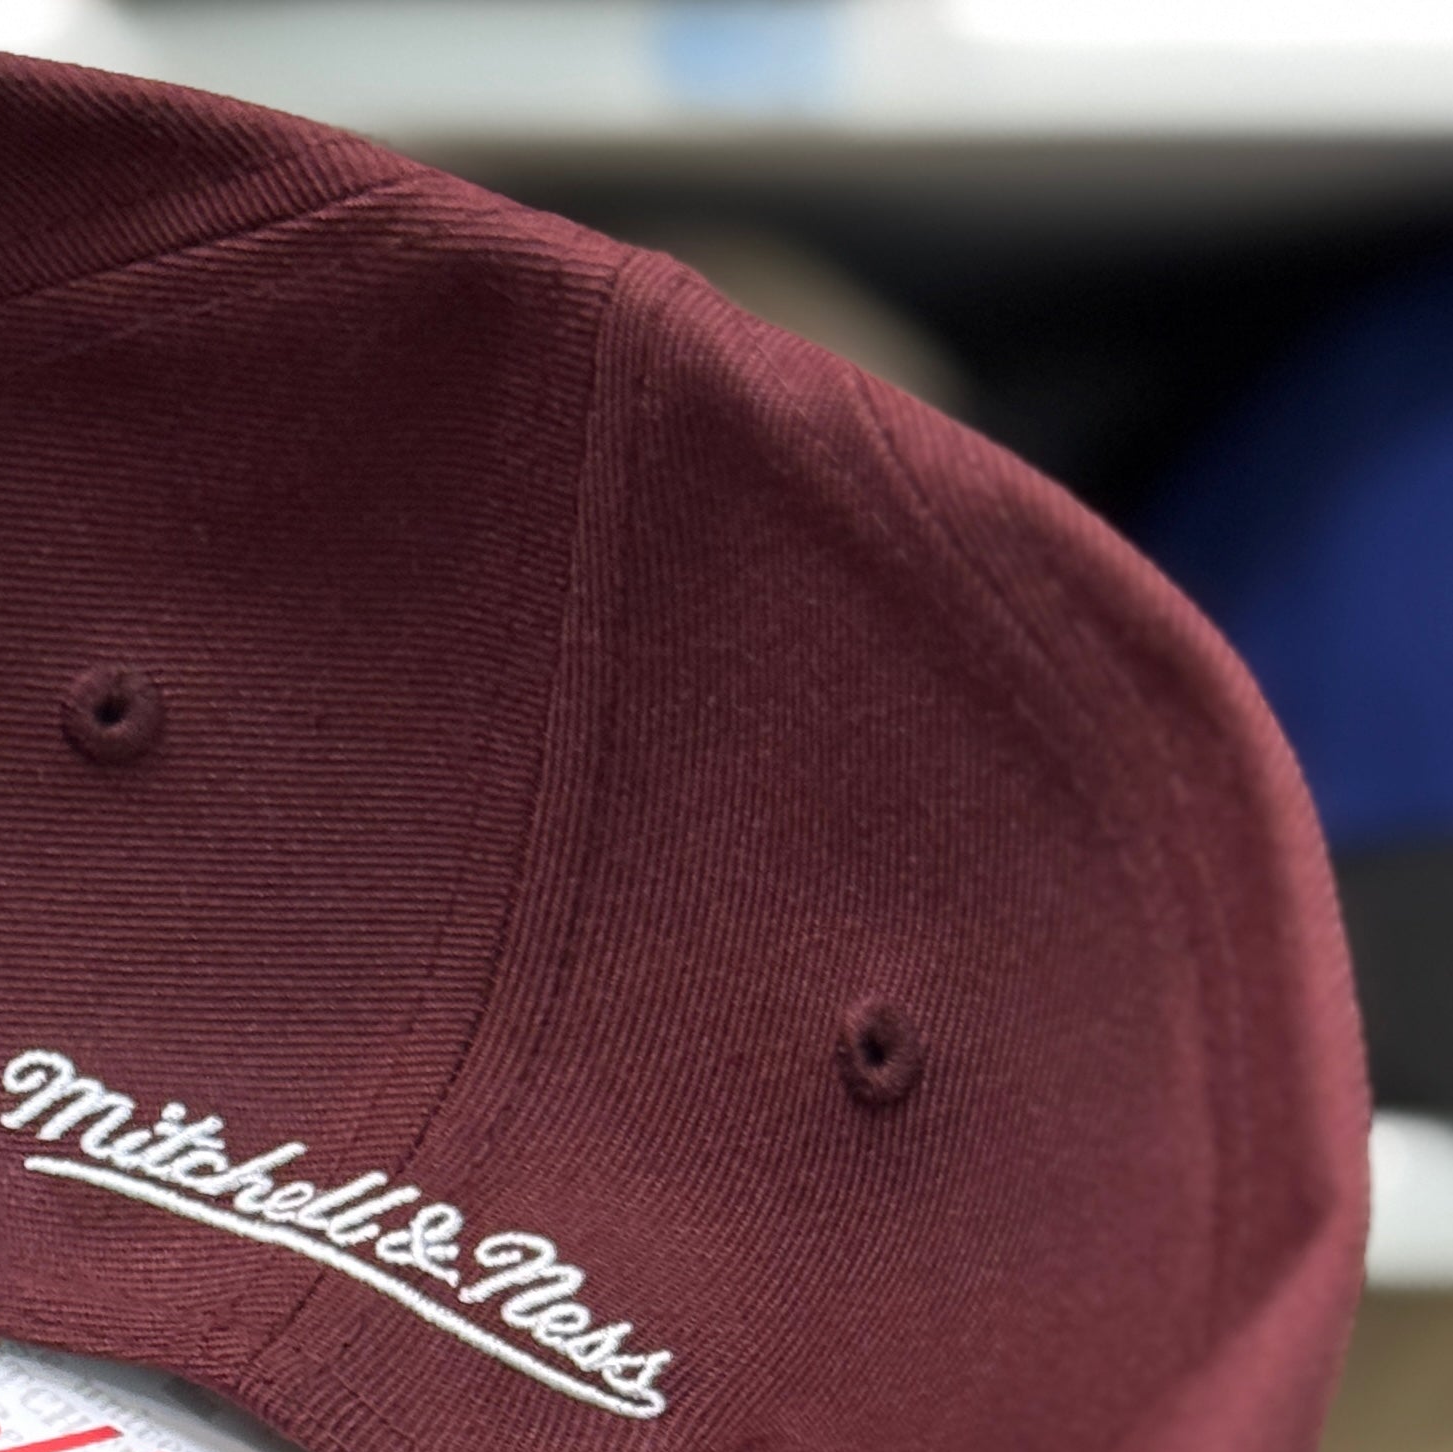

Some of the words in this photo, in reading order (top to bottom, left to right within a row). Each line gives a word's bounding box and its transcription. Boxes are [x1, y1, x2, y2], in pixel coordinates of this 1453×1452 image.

[0, 1049, 422, 1247] Mitchell
[377, 1202, 464, 1287] &
[459, 1232, 674, 1402] Ness
